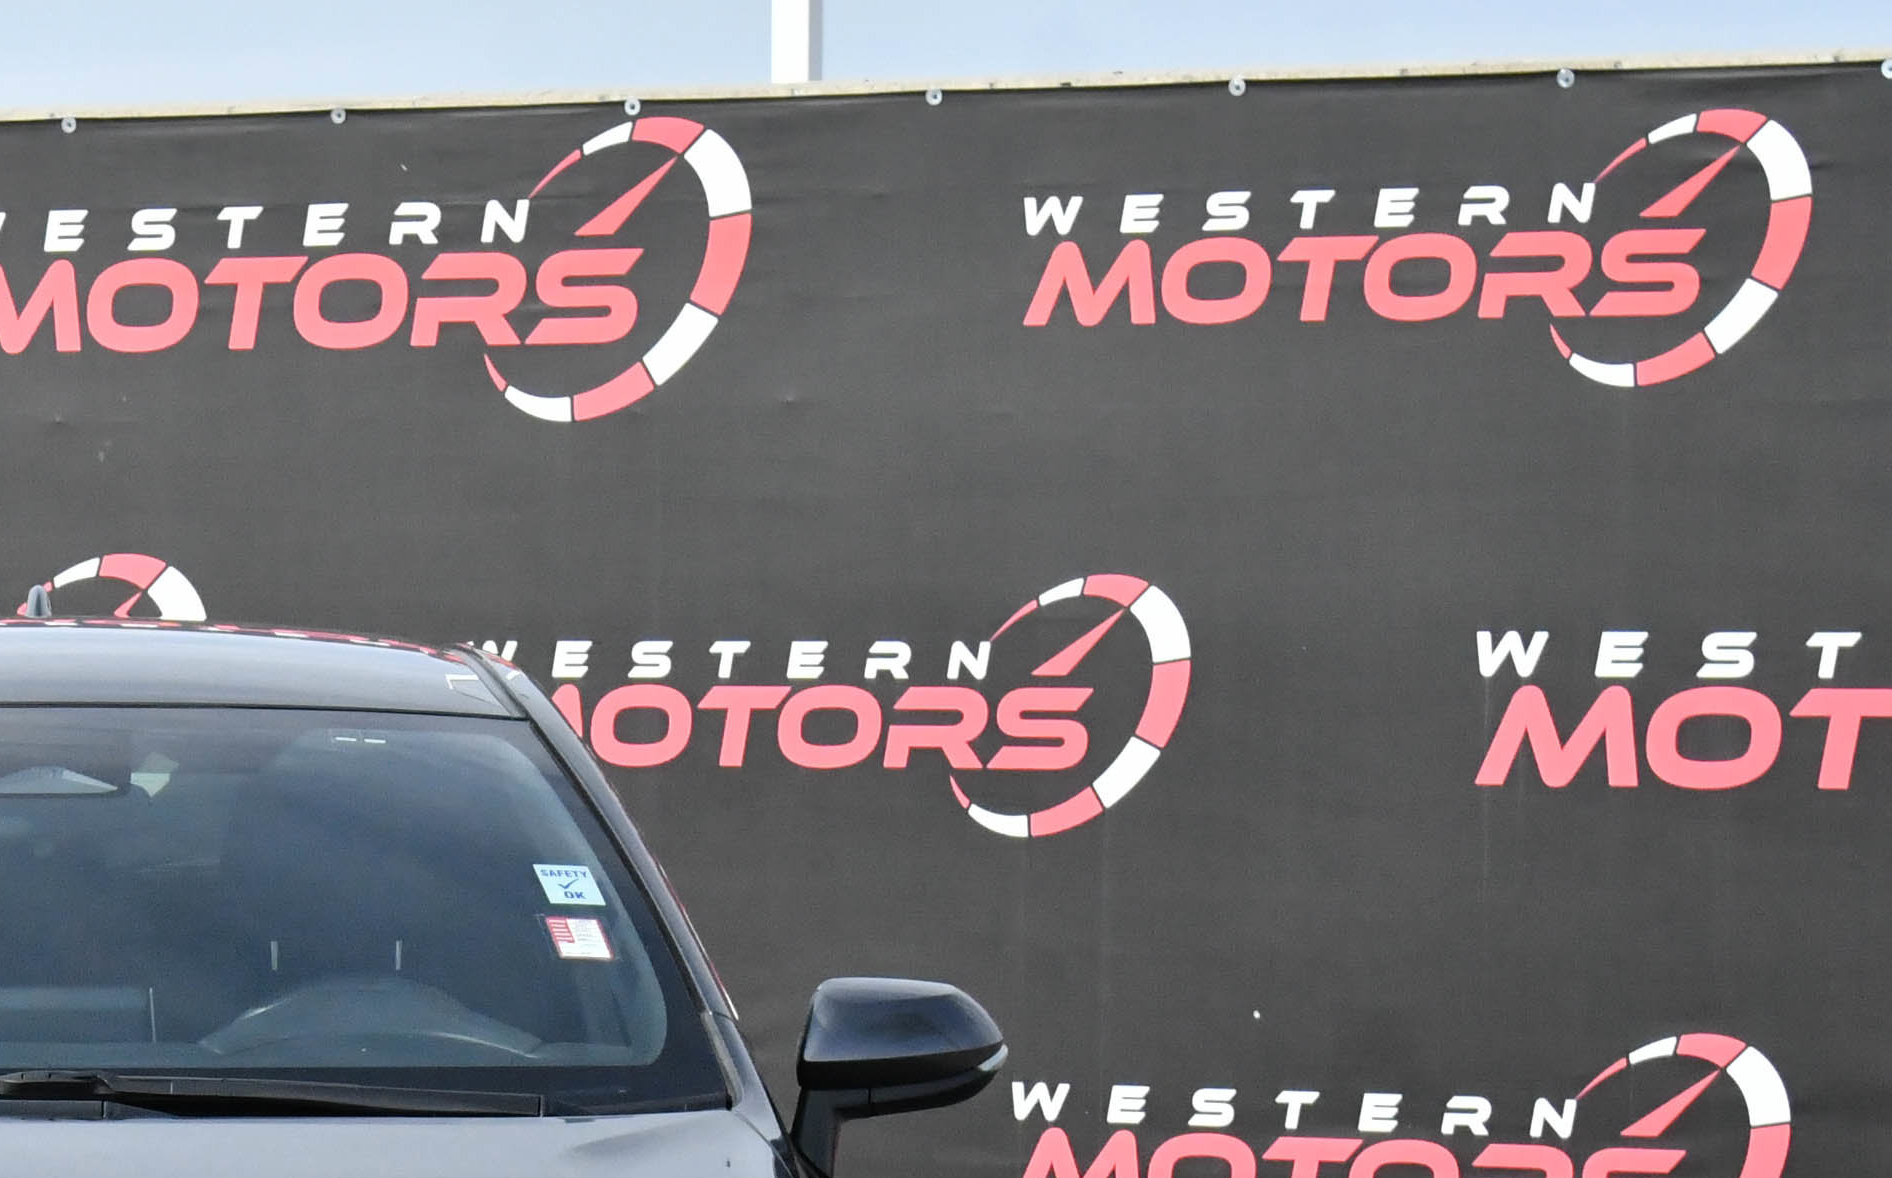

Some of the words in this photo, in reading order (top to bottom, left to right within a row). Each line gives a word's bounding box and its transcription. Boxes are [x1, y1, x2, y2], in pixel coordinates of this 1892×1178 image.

[1024, 183, 1596, 236] WESTERN
[1024, 228, 1706, 326] MOTORS
[1477, 631, 1862, 679] WEST
[1476, 684, 1892, 790] MOT
[540, 868, 587, 878] SAFETY
[563, 890, 587, 899] OK
[1012, 1082, 1577, 1139] WESTERN
